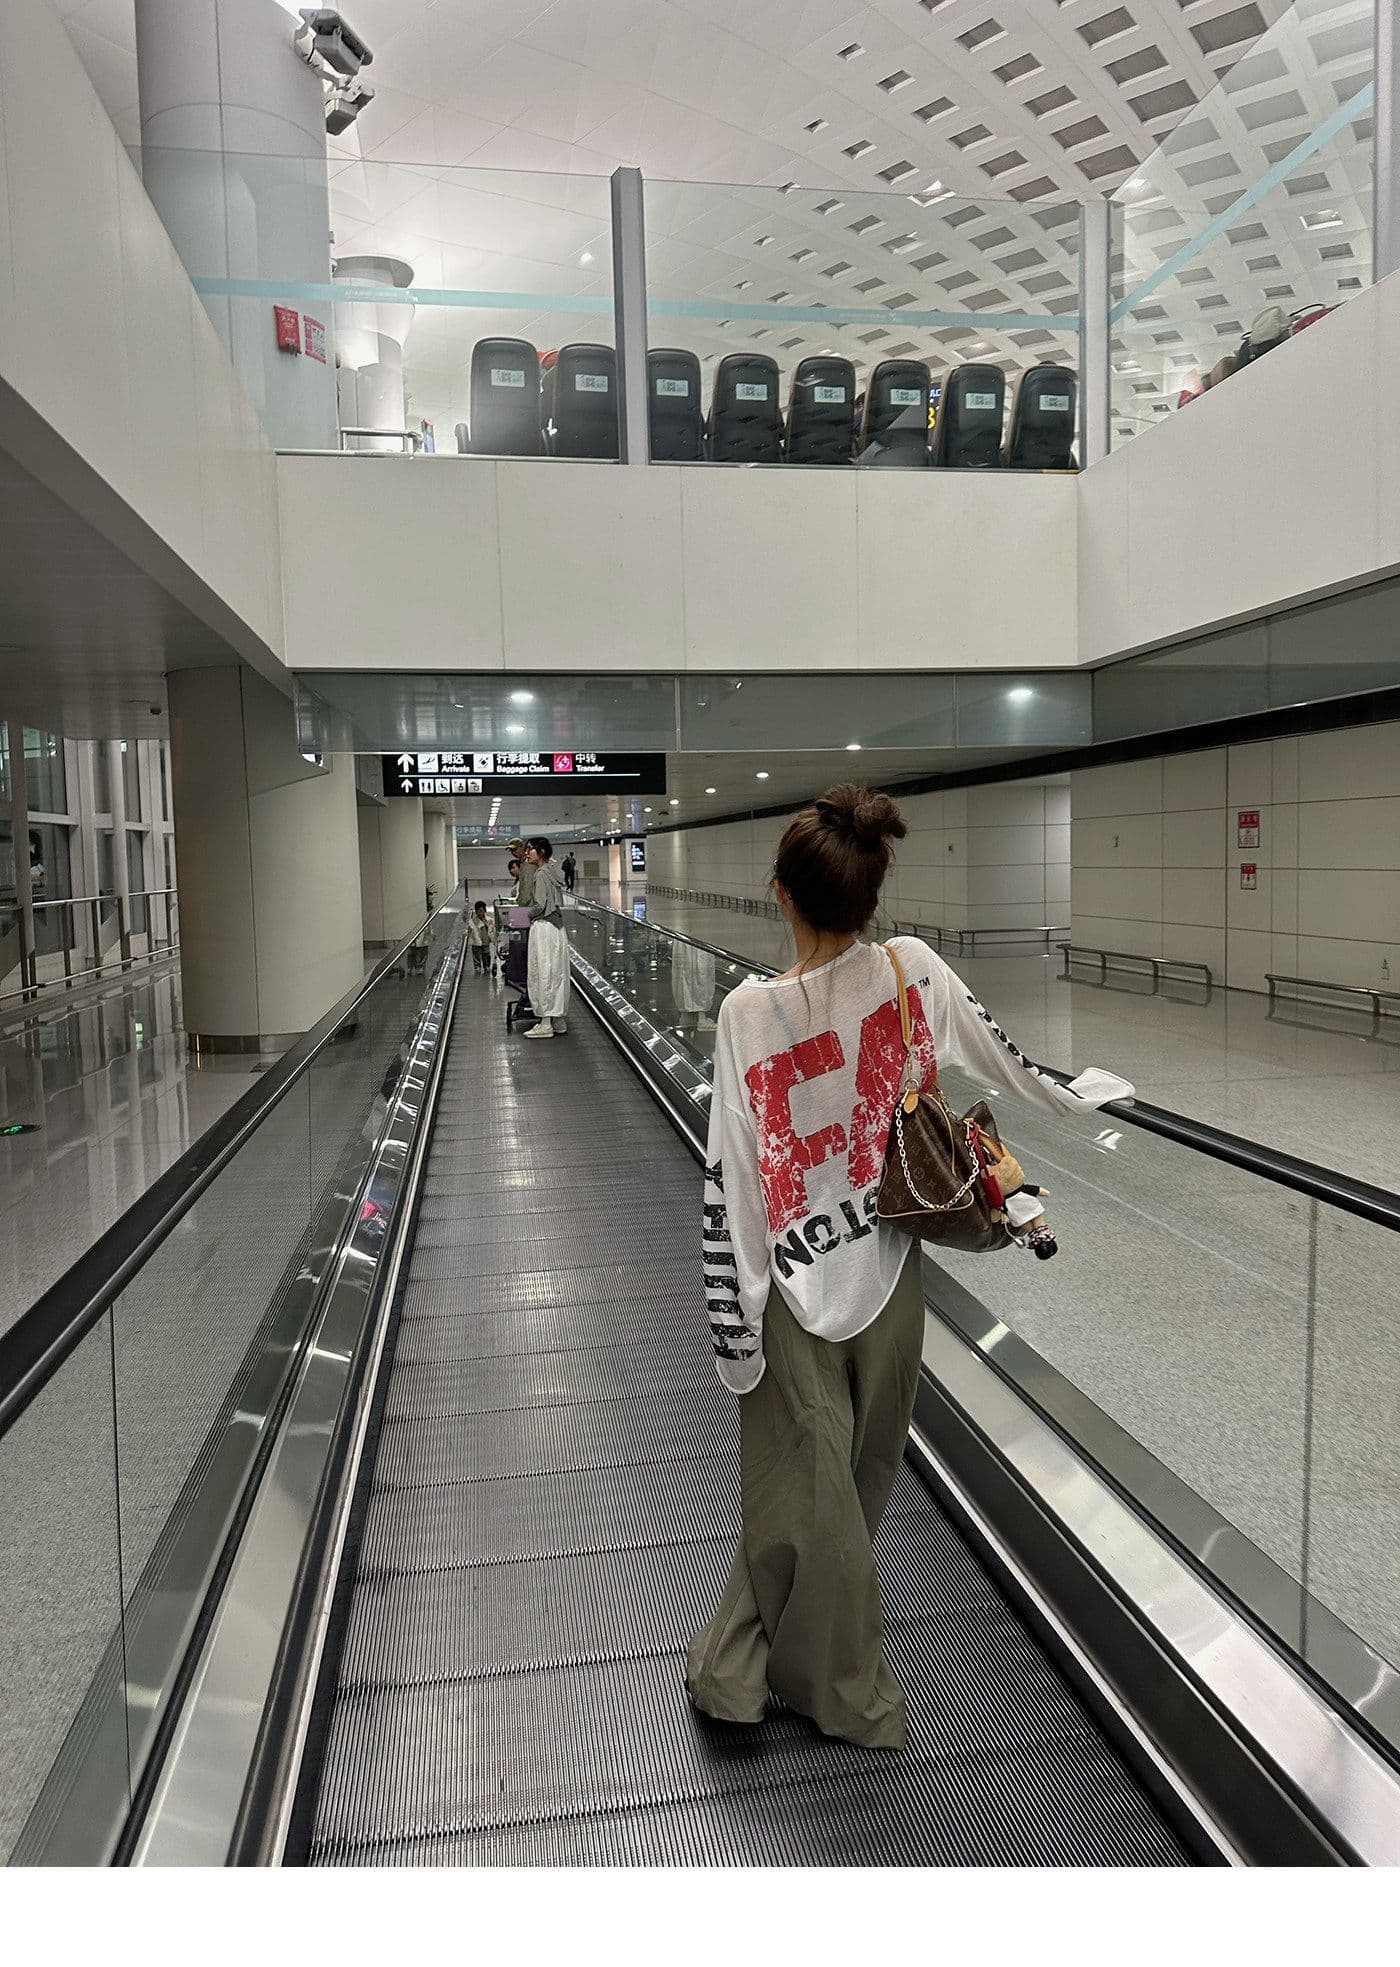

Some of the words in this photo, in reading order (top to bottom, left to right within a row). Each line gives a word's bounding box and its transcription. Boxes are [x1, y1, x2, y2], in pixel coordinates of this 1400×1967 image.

[496, 753, 540, 764] 行李提取
[575, 753, 596, 764] 中转
[441, 765, 470, 773] Arrivals
[496, 765, 528, 774] Baggage
[529, 765, 549, 773] Claim
[918, 976, 931, 989] TM
